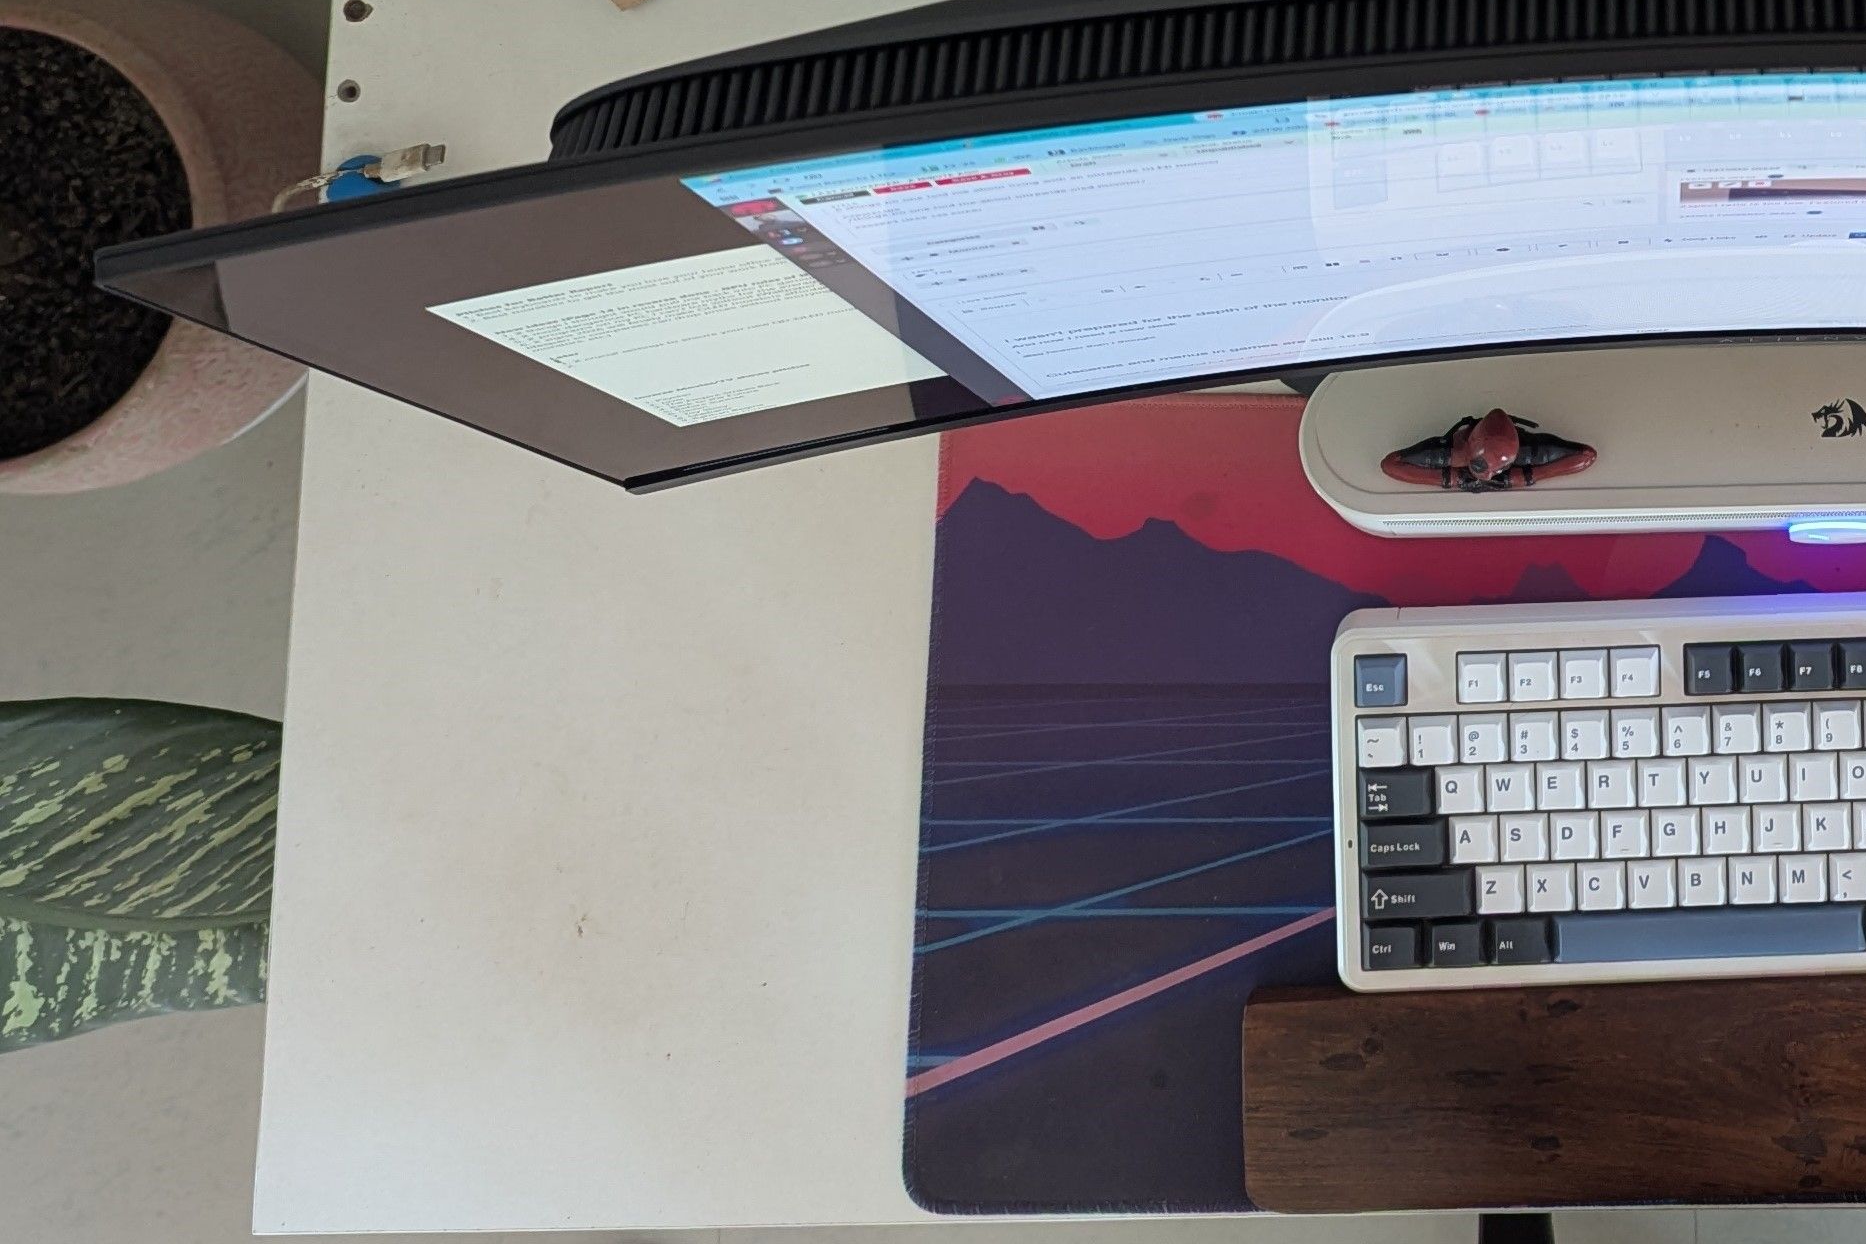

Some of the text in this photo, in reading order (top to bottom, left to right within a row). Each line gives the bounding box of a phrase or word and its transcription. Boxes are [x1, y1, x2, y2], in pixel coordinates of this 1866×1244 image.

[1068, 321, 1138, 334] prepared
[1196, 308, 1240, 316] depth
[1292, 296, 1348, 305] monitor
[1230, 343, 1278, 351] games
[1698, 670, 1710, 678] F5
[1749, 668, 1761, 676] F6
[1799, 667, 1812, 675] F7
[1850, 665, 1863, 673] F8
[1520, 678, 1532, 686] F2
[1570, 675, 1582, 684] F3
[1622, 674, 1634, 682] F4
[1366, 683, 1384, 692] Esc
[1468, 680, 1479, 688] F1
[1622, 726, 1634, 736] %
[1724, 723, 1732, 732] &
[1468, 731, 1479, 742] @
[1520, 730, 1528, 740] #
[1571, 728, 1579, 739] $
[1825, 733, 1833, 743] 9
[1674, 739, 1681, 748] 6
[1725, 737, 1731, 746] 7
[1775, 735, 1782, 744] 8
[1520, 745, 1528, 754] 3
[1571, 743, 1579, 752] 4
[1622, 741, 1629, 750] 5
[1418, 749, 1424, 758] 1
[1469, 746, 1477, 756] 2
[1751, 770, 1763, 783] U
[1852, 766, 1865, 779] O
[1547, 777, 1558, 789] E
[1599, 775, 1610, 788] R
[1648, 774, 1659, 787] T
[1699, 771, 1710, 785] Y
[1445, 780, 1458, 794] Q
[1495, 778, 1511, 792] W
[1368, 793, 1387, 802] Tab
[1714, 821, 1726, 834] H
[1765, 819, 1774, 832] J
[1816, 817, 1827, 830] K
[1562, 827, 1573, 840] D
[1612, 825, 1622, 838] F
[1663, 823, 1676, 836] G
[1459, 830, 1472, 844] A
[1510, 828, 1522, 842] S
[1370, 842, 1420, 854] Caps Lock
[1691, 873, 1701, 886] B
[1741, 871, 1753, 885] N
[1792, 869, 1805, 883] M
[1486, 880, 1496, 894] Z
[1537, 879, 1547, 892] X
[1588, 877, 1600, 891] C
[1639, 875, 1650, 889] V
[1391, 894, 1415, 904] Shift
[1372, 944, 1391, 954] Ctrl
[1439, 941, 1456, 951] Win
[1499, 940, 1513, 950] Alt
